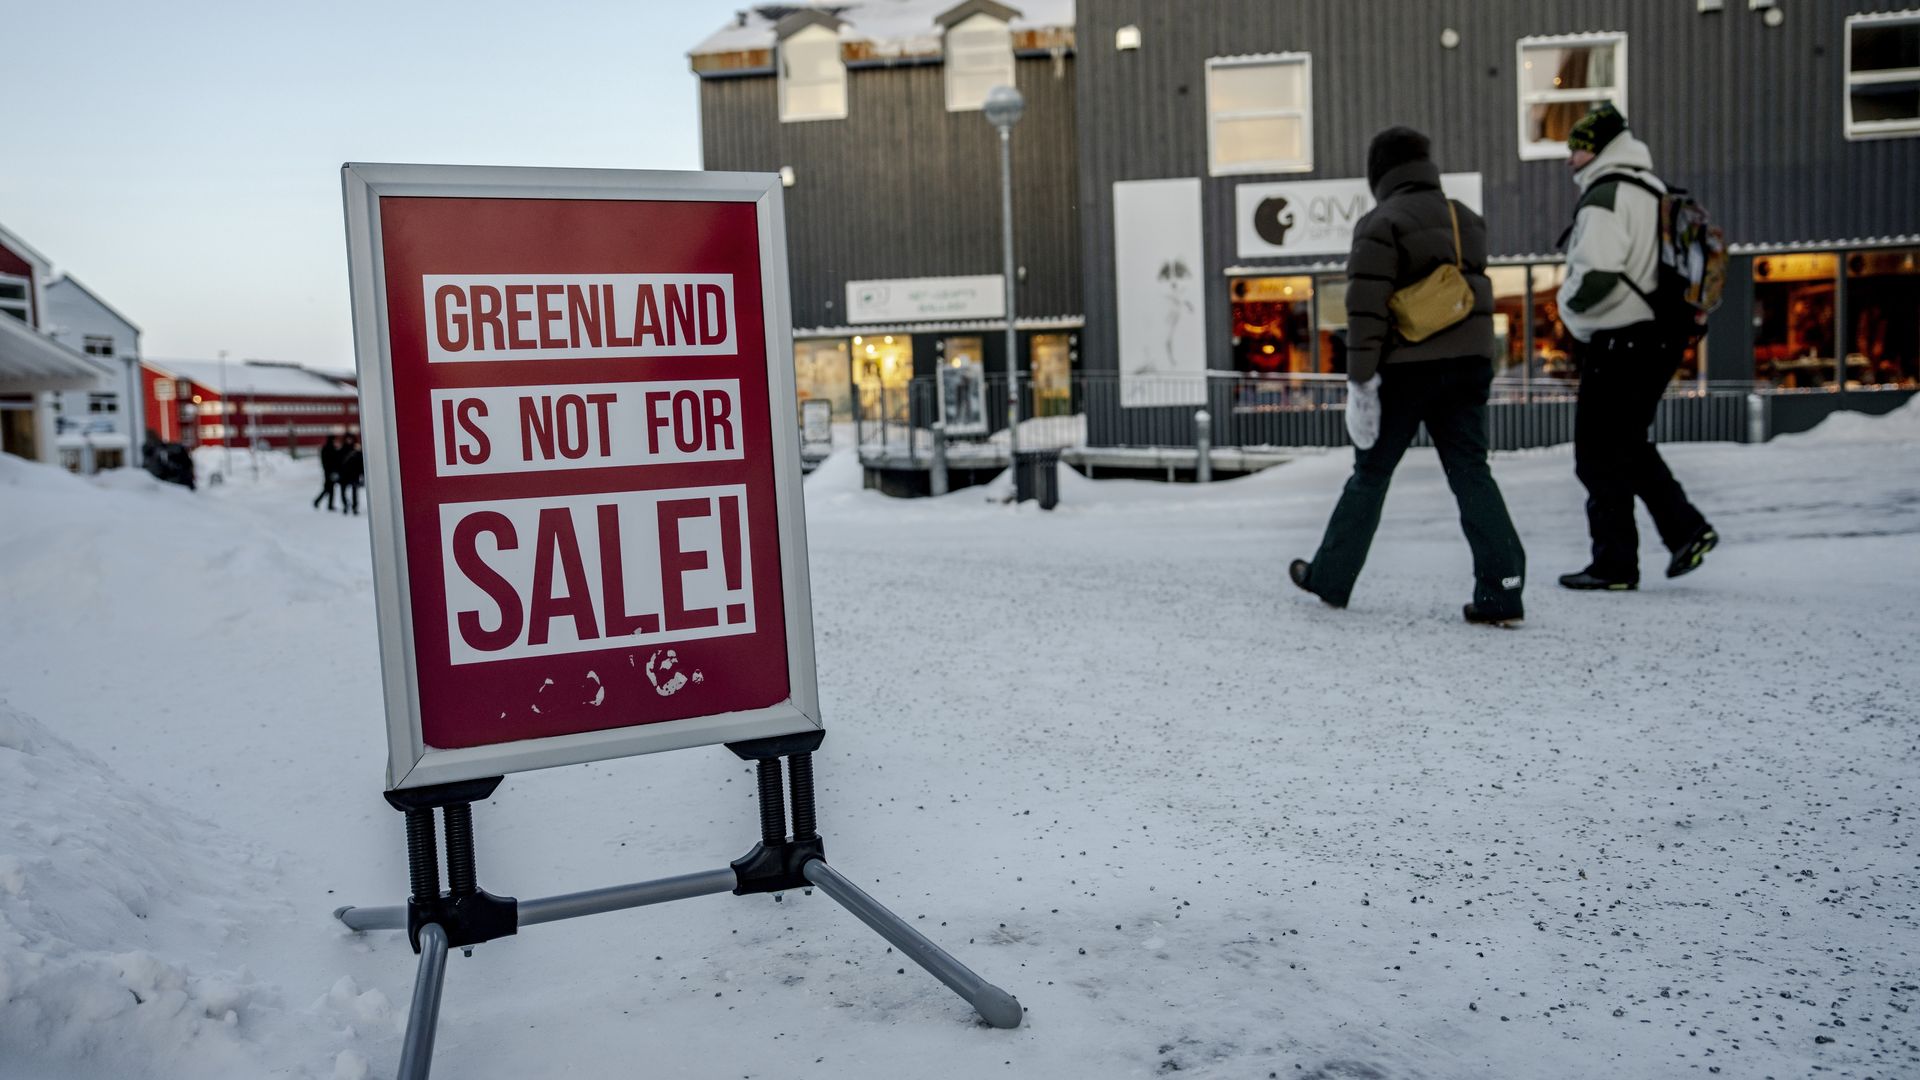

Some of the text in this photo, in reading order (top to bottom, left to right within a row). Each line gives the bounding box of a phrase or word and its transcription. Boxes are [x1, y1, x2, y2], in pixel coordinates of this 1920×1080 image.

[435, 283, 728, 352] GREENLAND
[442, 389, 735, 466] IS NOT FOR
[452, 495, 747, 652] SALE!
